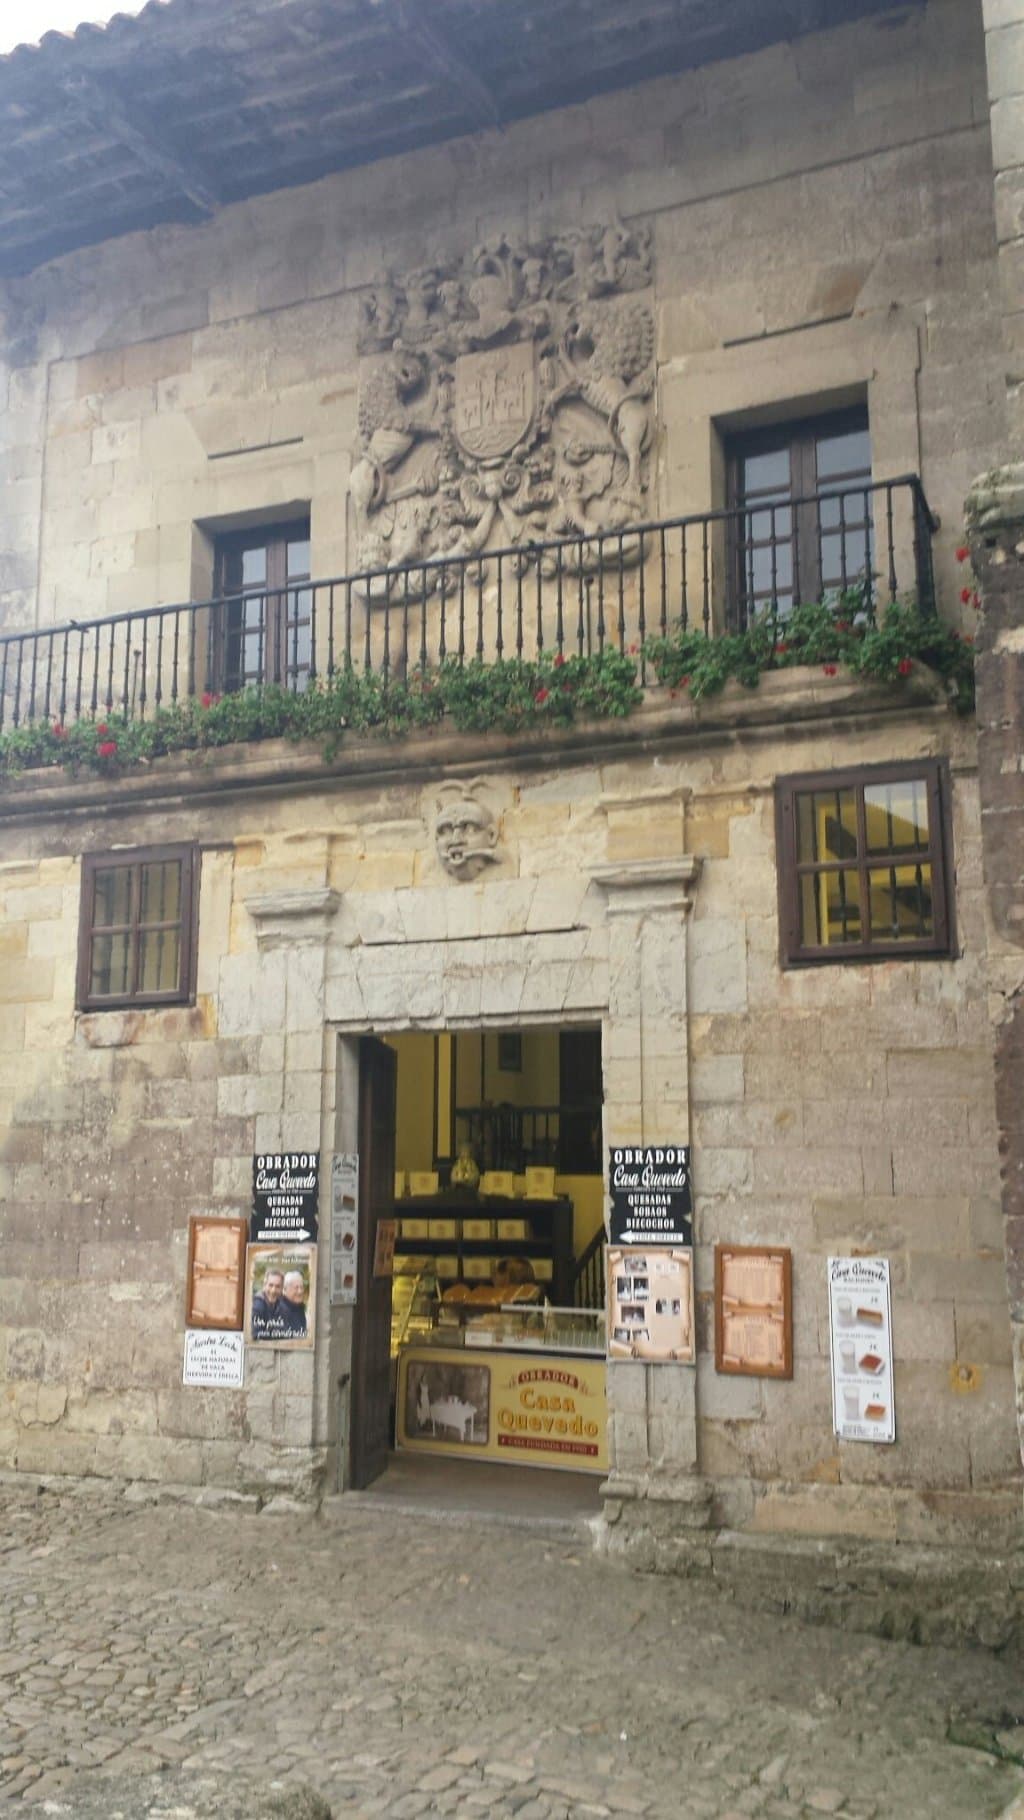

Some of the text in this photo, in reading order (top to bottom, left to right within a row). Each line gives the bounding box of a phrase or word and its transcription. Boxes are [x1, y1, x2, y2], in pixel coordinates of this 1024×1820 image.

[257, 1155, 316, 1169] OBRADOR
[614, 1149, 686, 1165] OBRADOR
[256, 1168, 316, 1193] Casa Quevedo
[613, 1163, 686, 1188] Casa Quevedo
[267, 1195, 303, 1208] QUESADAS
[627, 1194, 671, 1207] QUESADAS
[633, 1206, 667, 1217] SOBAOS
[626, 1218, 675, 1230] BIZCOCHOS
[521, 1369, 576, 1388] OBRADOR
[520, 1387, 576, 1413] Casa
[498, 1407, 599, 1438] Quevedo
